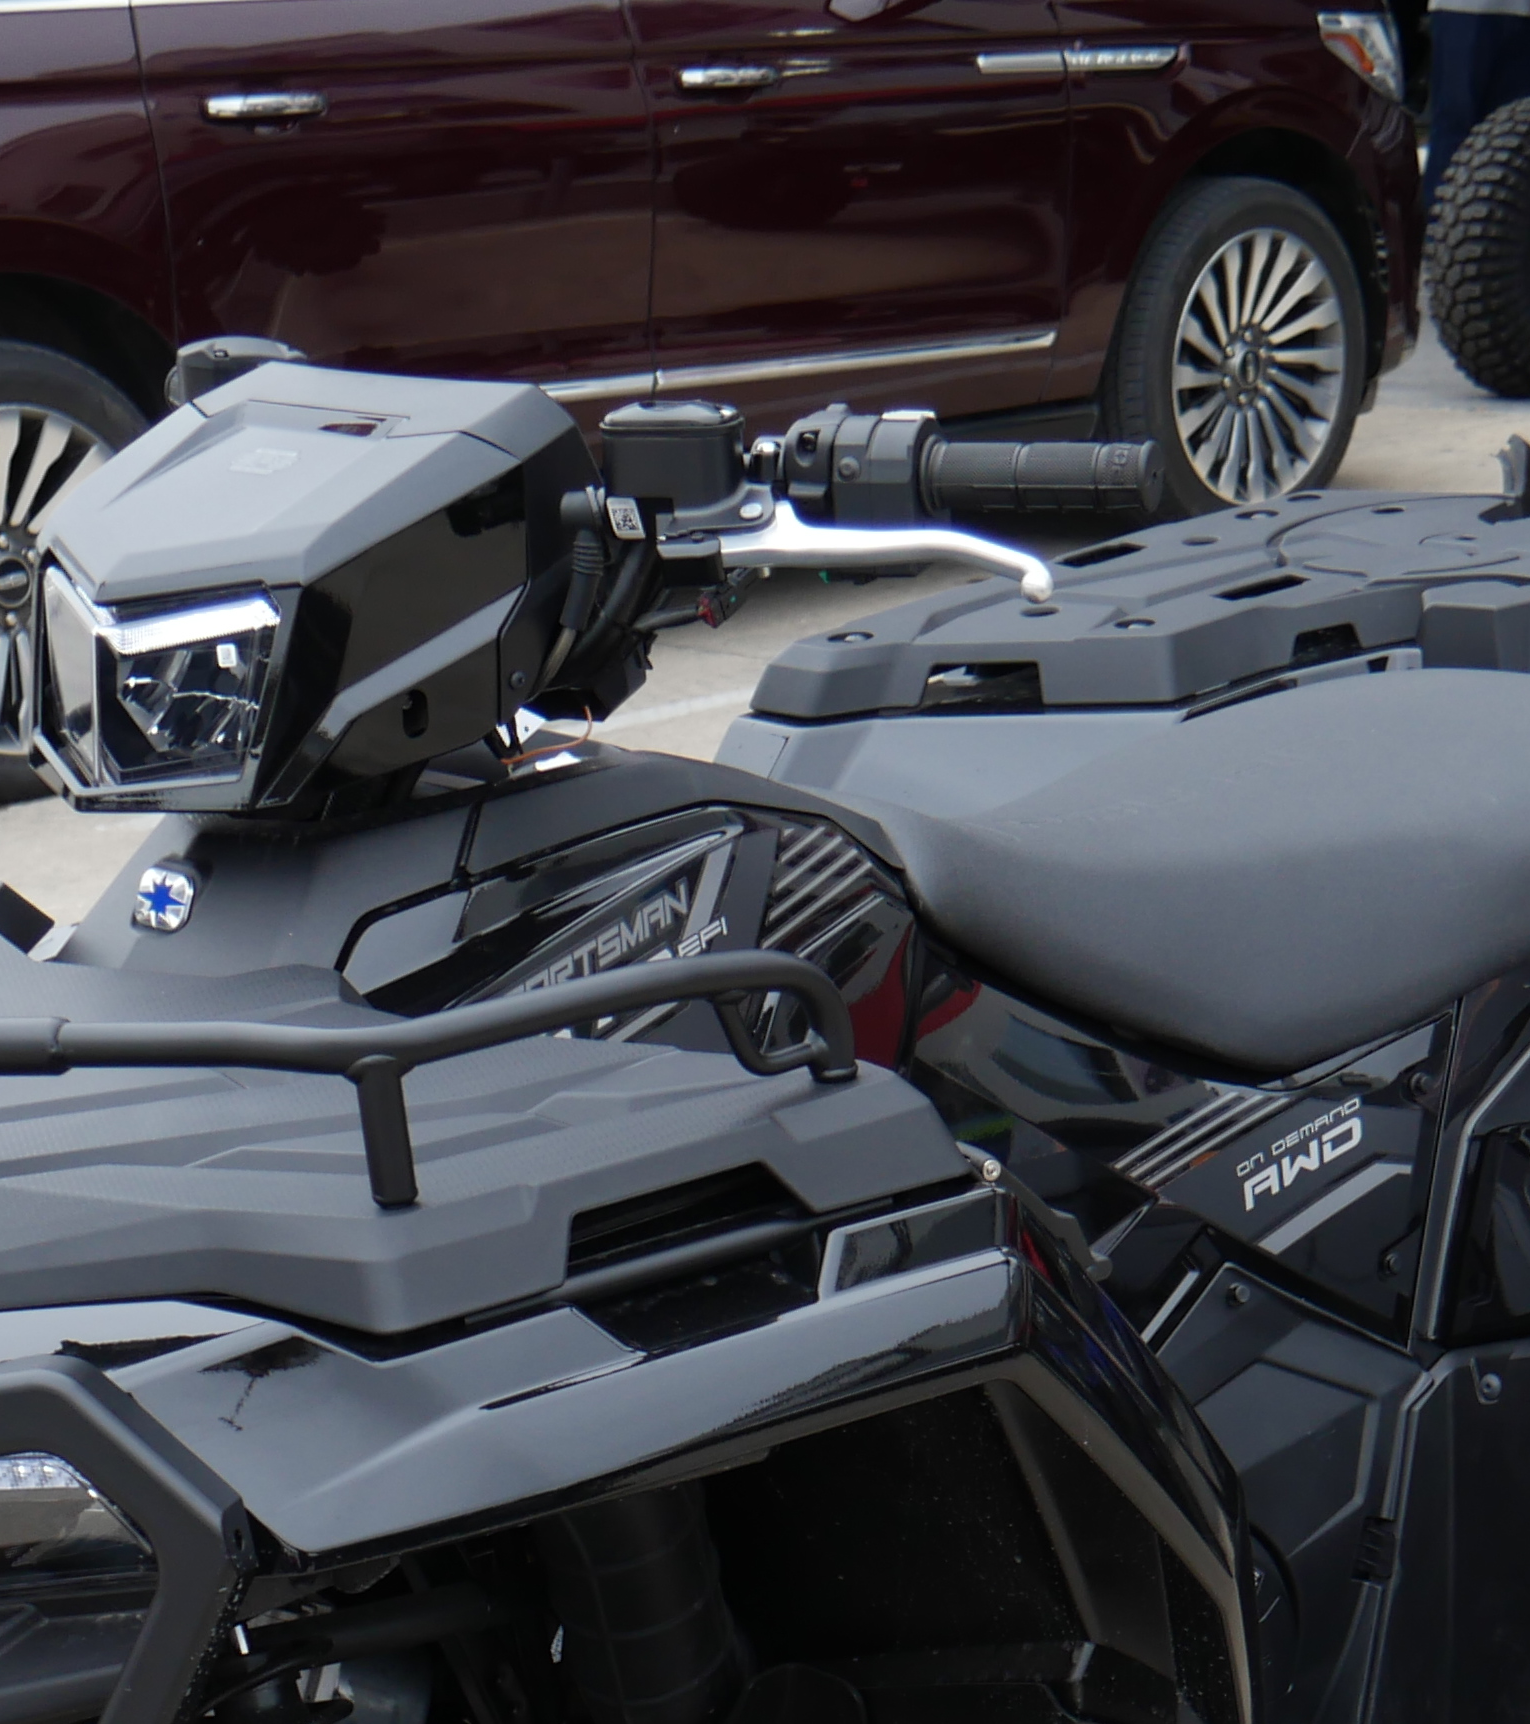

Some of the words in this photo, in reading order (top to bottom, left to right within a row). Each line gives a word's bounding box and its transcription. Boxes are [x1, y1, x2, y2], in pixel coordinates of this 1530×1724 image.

[676, 915, 728, 959] EFI
[1235, 1151, 1266, 1178] ON
[1270, 1096, 1361, 1157] DEMAND
[1242, 1116, 1363, 1213] AWD
